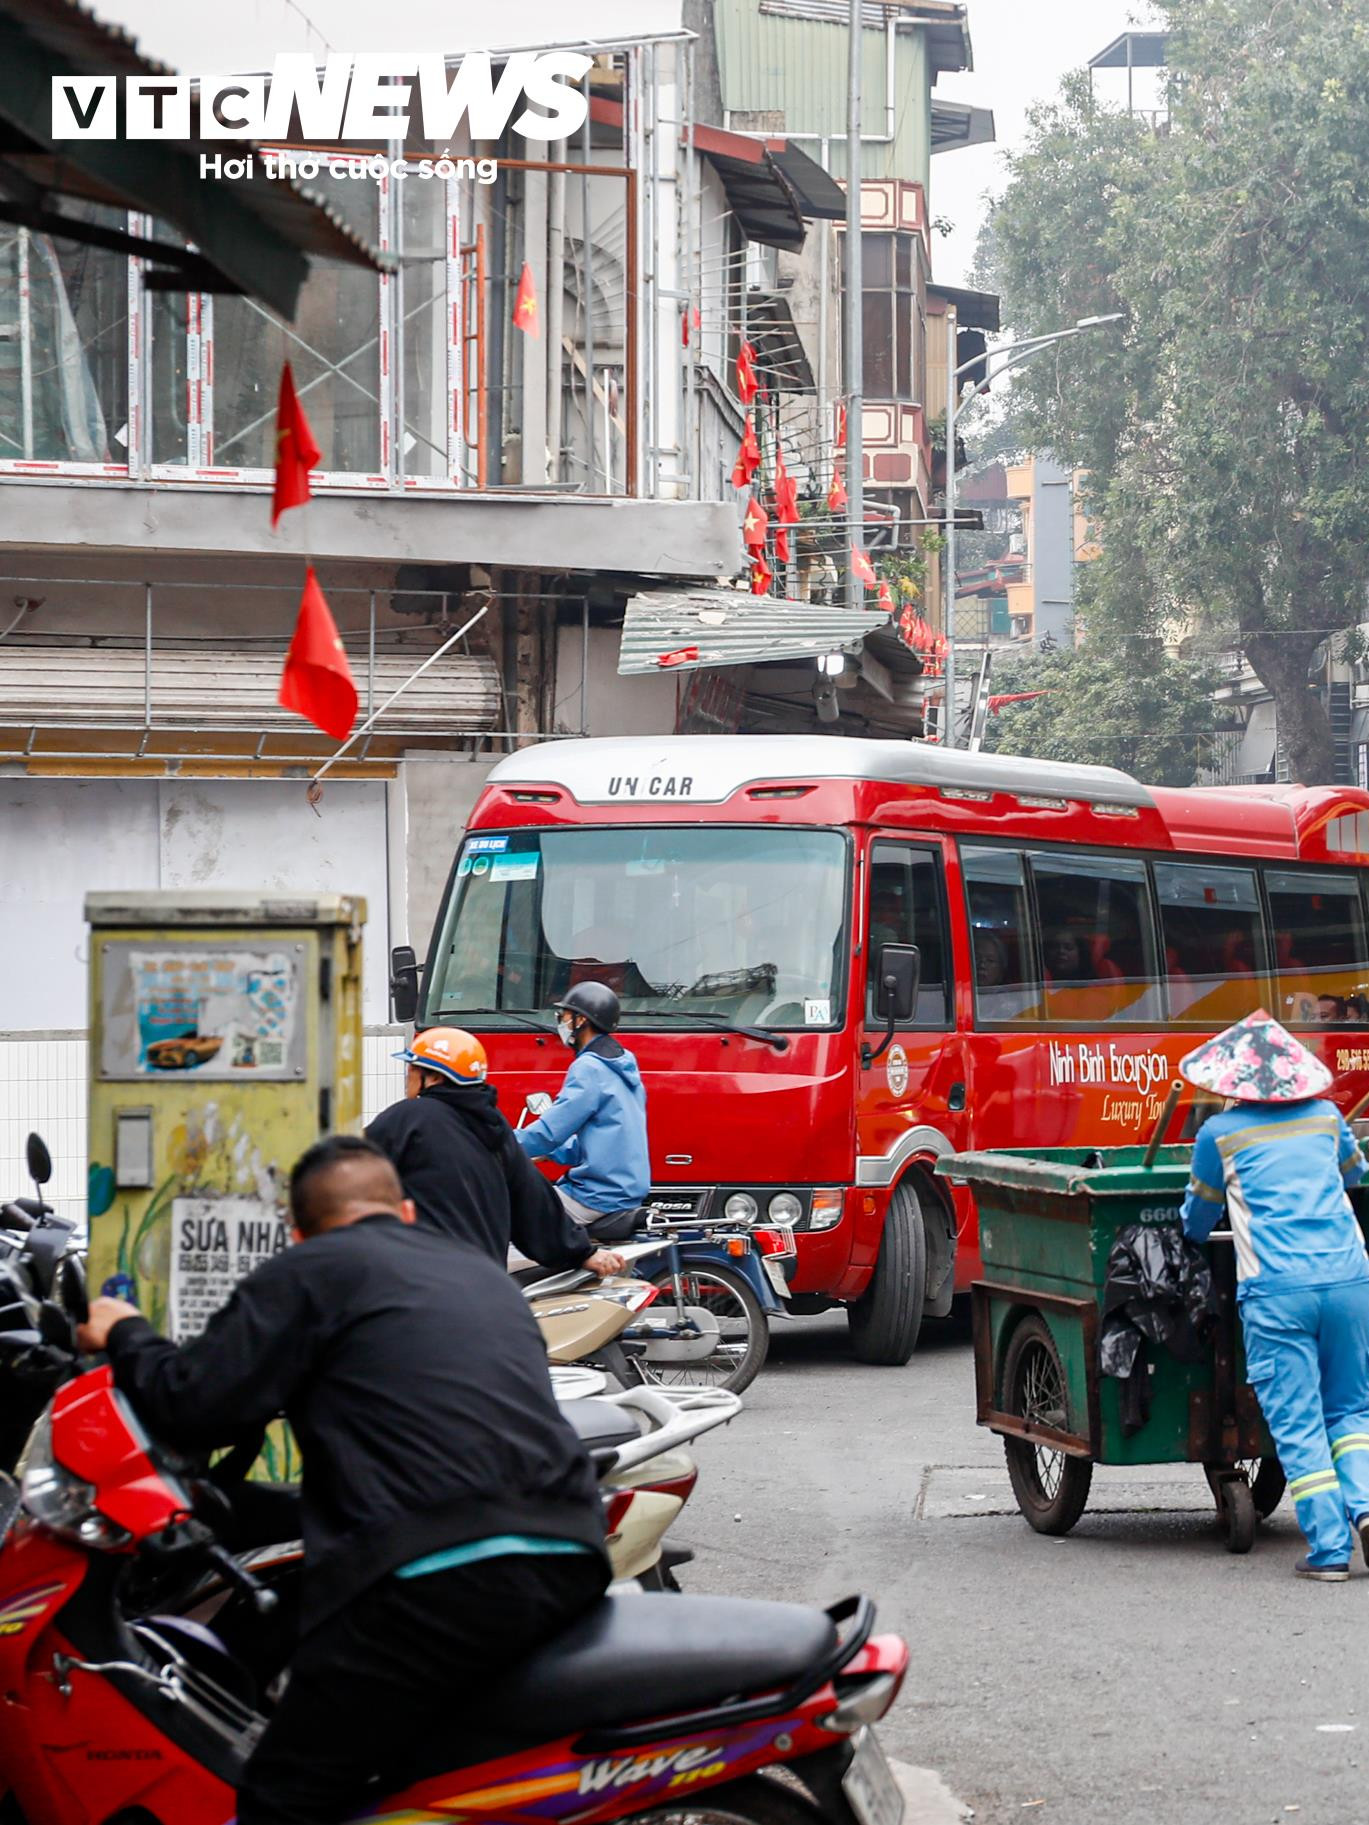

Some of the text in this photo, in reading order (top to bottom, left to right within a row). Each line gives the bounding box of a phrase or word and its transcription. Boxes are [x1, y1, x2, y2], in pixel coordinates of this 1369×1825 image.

[1049, 1040, 1168, 1095] Ninh Binh Excursion
[1101, 1094, 1143, 1130] Luxury
[578, 1746, 725, 1796] Wave
